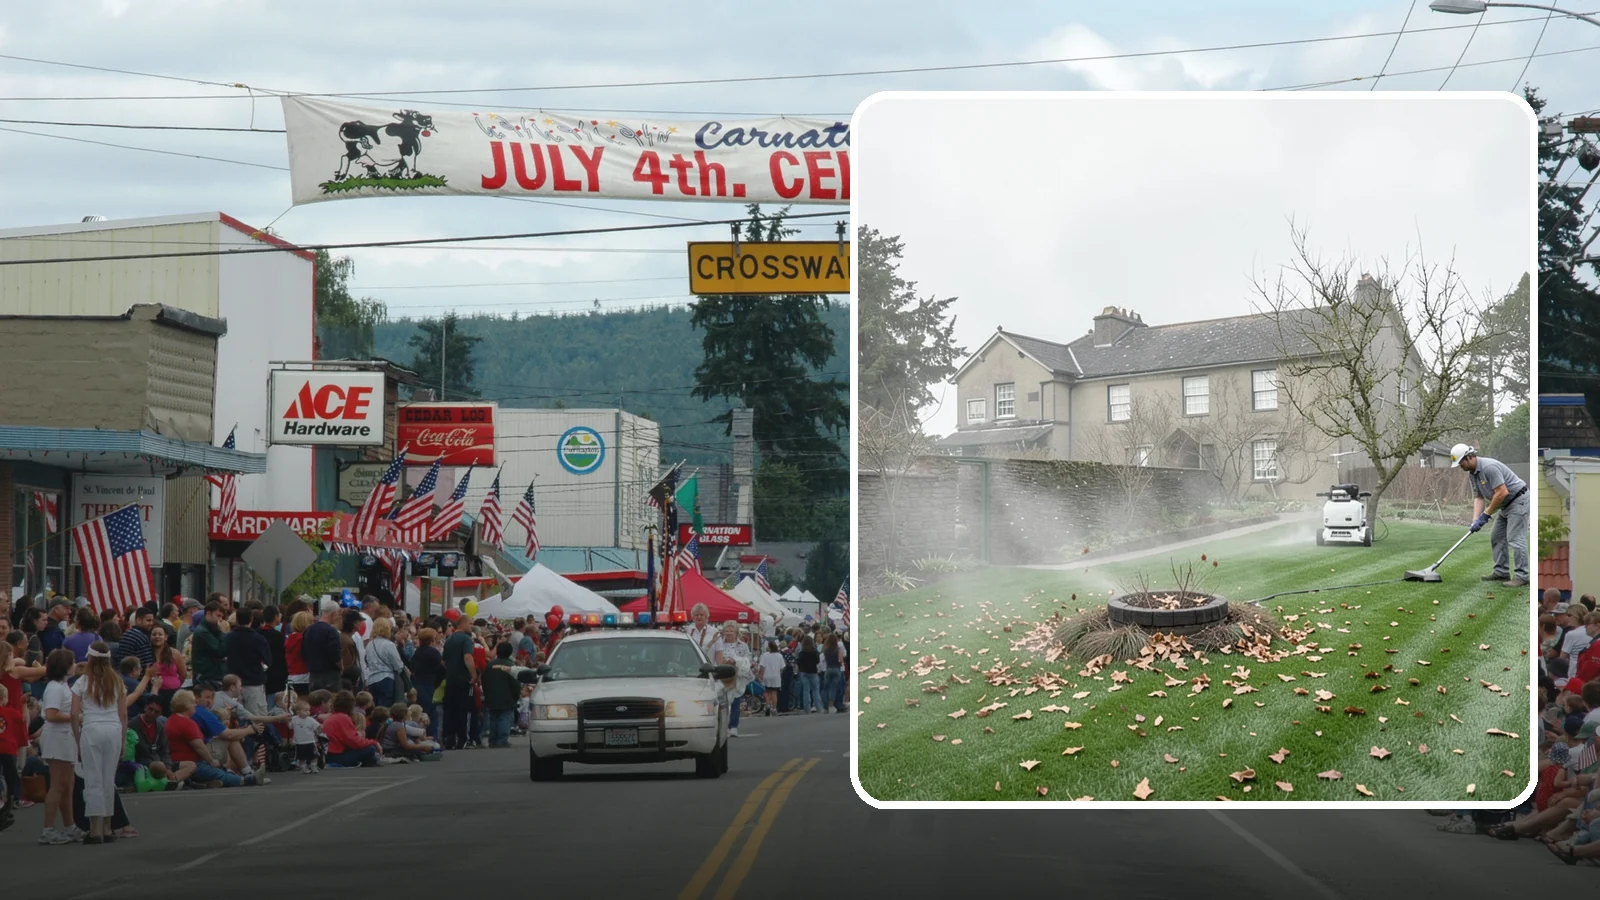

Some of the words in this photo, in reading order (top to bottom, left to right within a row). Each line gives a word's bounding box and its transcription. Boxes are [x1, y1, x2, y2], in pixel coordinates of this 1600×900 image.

[695, 121, 850, 150] Carnat
[481, 141, 605, 193] JULY
[632, 150, 746, 198] 4th.
[697, 254, 850, 280] CROSSWA
[282, 380, 373, 420] ACE
[406, 409, 453, 422] CEDAR
[461, 409, 485, 422] LOG
[283, 421, 370, 436] Hardware
[353, 467, 385, 481] Simpl
[96, 485, 124, 495] Vincent
[126, 486, 136, 495] de
[138, 486, 155, 496] Paul
[688, 526, 741, 535] CRNATION
[699, 535, 730, 543] GLASS
